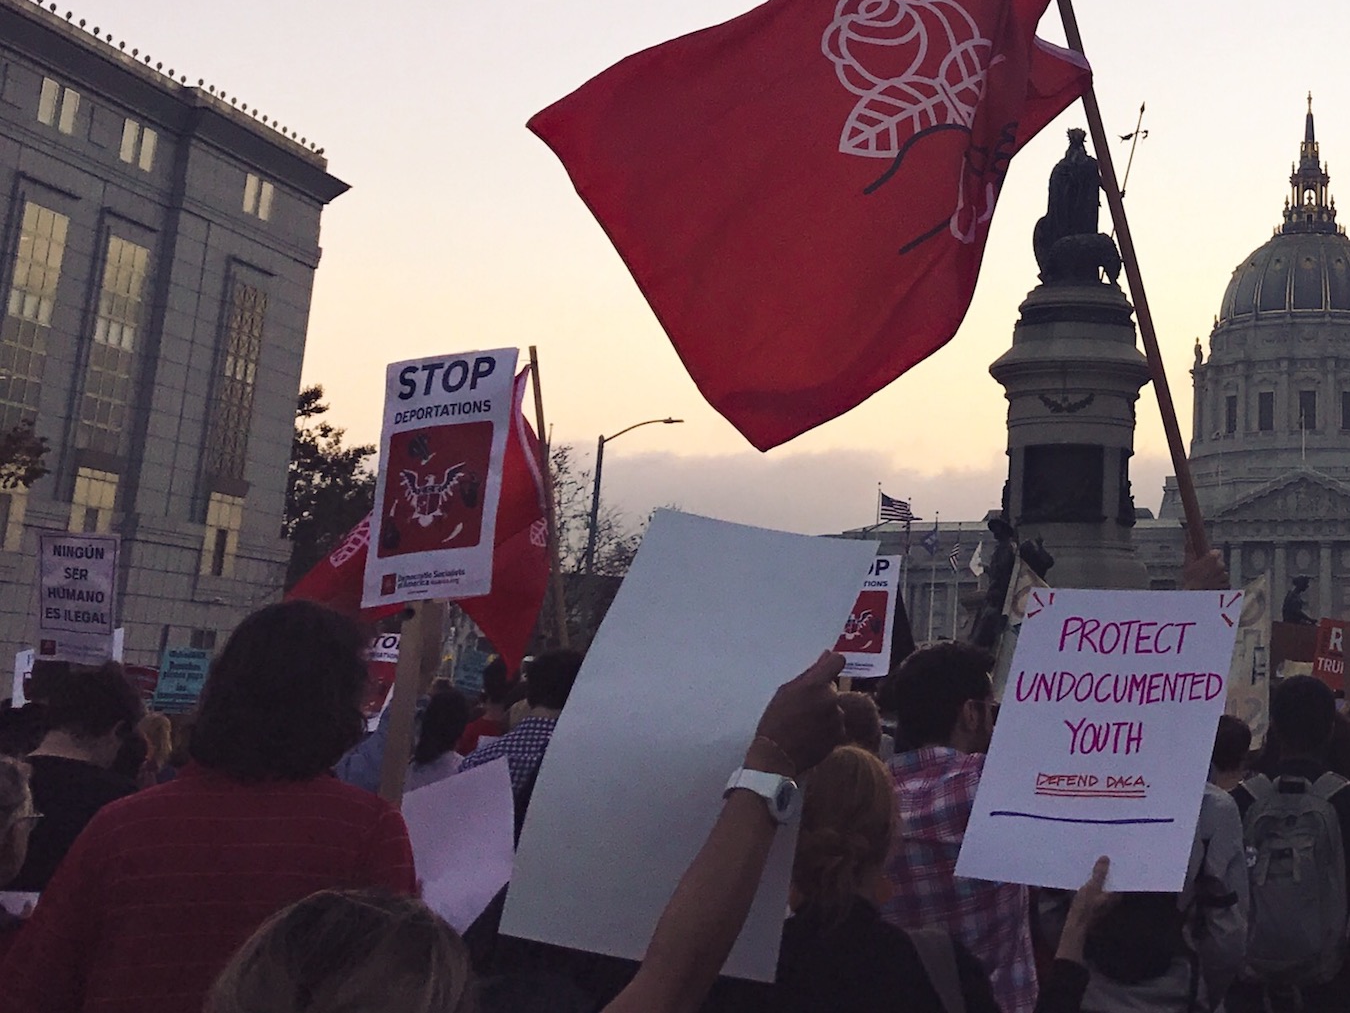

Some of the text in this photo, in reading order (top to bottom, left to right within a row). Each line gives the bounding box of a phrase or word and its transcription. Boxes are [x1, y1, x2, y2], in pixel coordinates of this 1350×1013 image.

[397, 355, 497, 401] STOP
[394, 399, 492, 425] DEPORTATIONS
[53, 544, 104, 560] NINGÚN
[64, 567, 89, 581] SER
[47, 587, 105, 603] HUMANO
[45, 607, 108, 625] ES ILEGAL
[1058, 616, 1197, 655] PROTECT
[1015, 670, 1224, 706] UNDOCUMENTED
[1063, 717, 1144, 755] YOUTH
[1036, 772, 1099, 787] DEFEND
